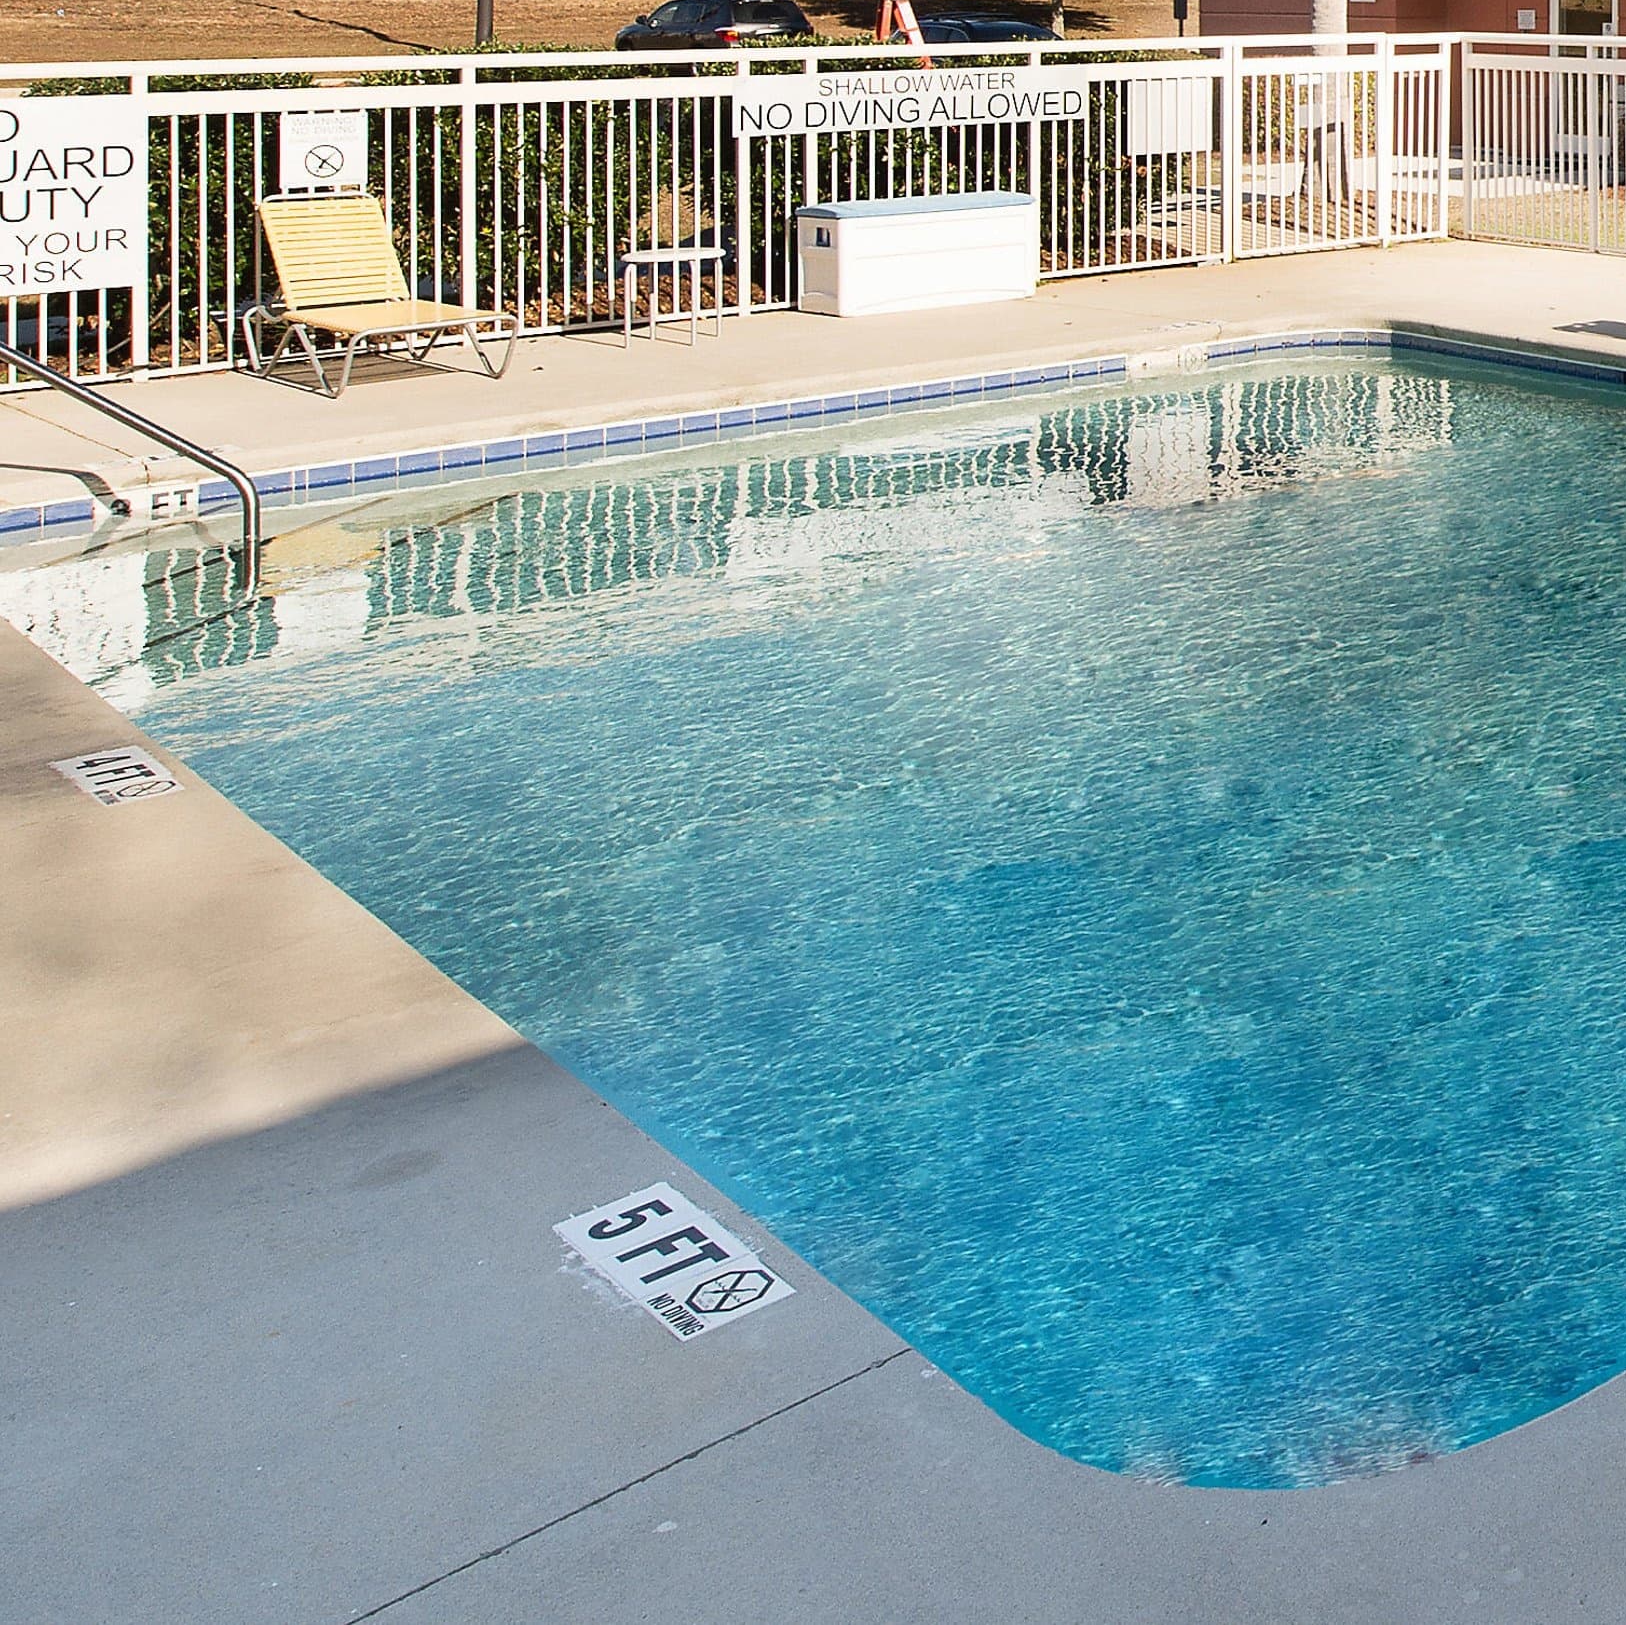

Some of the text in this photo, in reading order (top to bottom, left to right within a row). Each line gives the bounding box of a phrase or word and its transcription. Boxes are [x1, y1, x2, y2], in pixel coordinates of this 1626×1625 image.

[818, 72, 1016, 97] SHALLOW WATER
[740, 91, 1083, 131] NO DIVING ALLOWED
[16, 229, 128, 256] YOUR
[0, 259, 83, 285] RISK
[76, 755, 156, 786] 4 FT
[588, 1199, 730, 1285] 5 FT
[646, 1292, 705, 1337] NO DIVING
